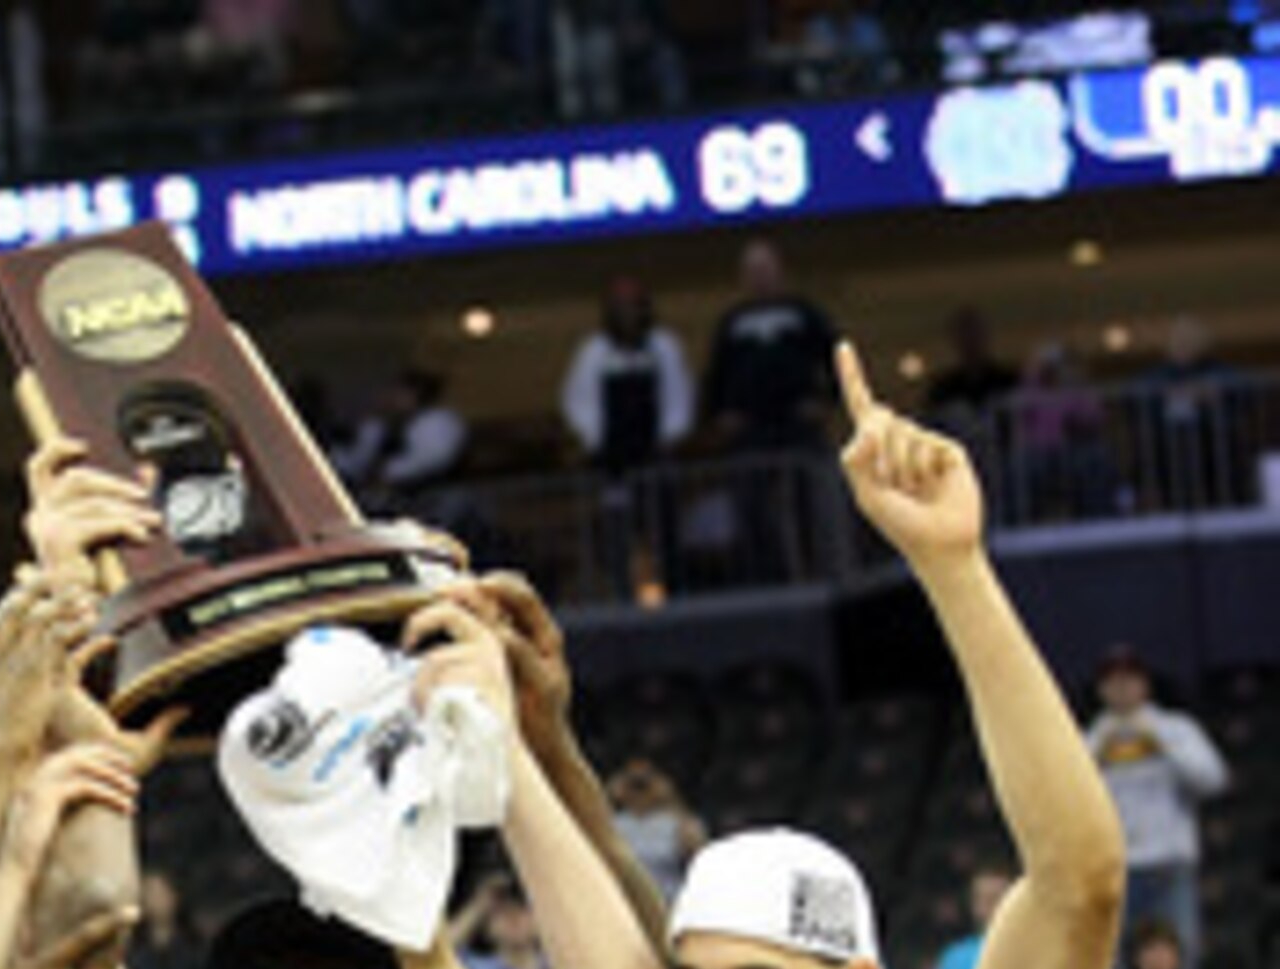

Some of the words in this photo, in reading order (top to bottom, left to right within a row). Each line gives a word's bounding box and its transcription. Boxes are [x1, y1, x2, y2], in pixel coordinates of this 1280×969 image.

[231, 176, 403, 252] NORTH
[408, 151, 674, 232] CAROLINA
[699, 121, 808, 212] 69
[63, 285, 185, 337] NCAA
